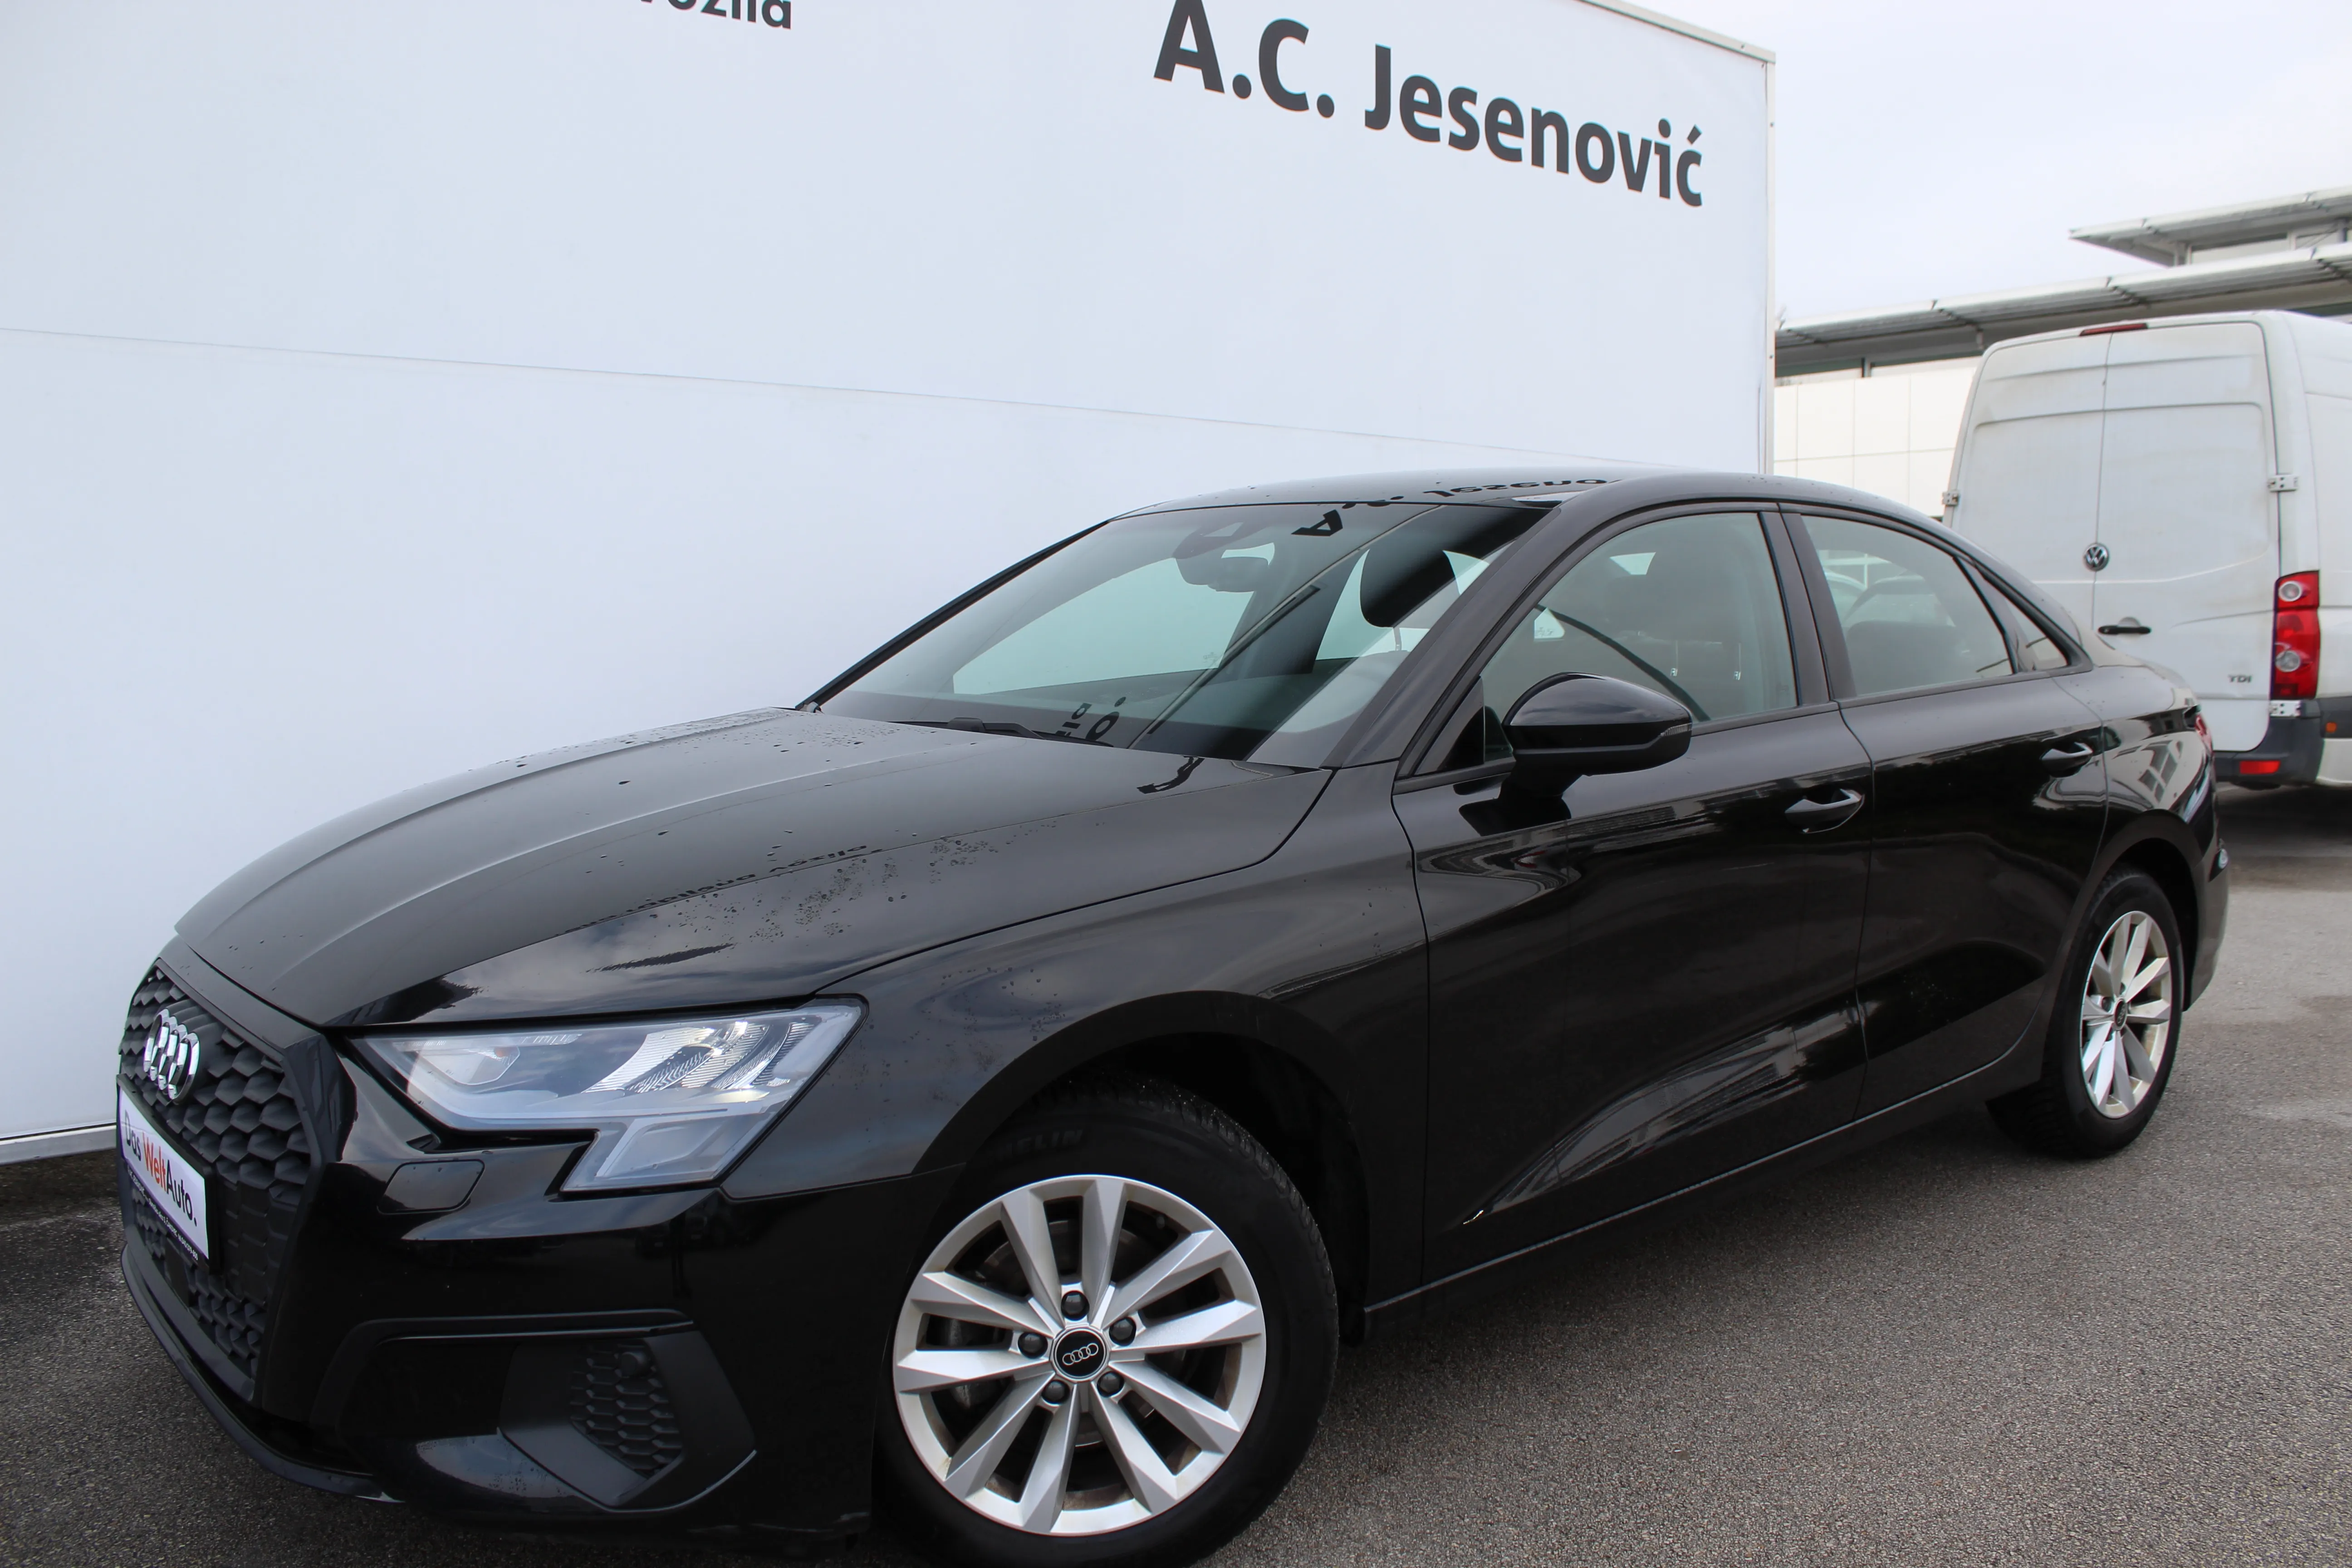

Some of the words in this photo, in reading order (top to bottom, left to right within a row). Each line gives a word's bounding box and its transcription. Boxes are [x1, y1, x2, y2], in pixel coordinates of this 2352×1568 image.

[1153, 0, 1335, 118] A.C.
[1365, 44, 1703, 207] Jesenović
[2228, 674, 2252, 683] TDI
[125, 1109, 141, 1161] Das
